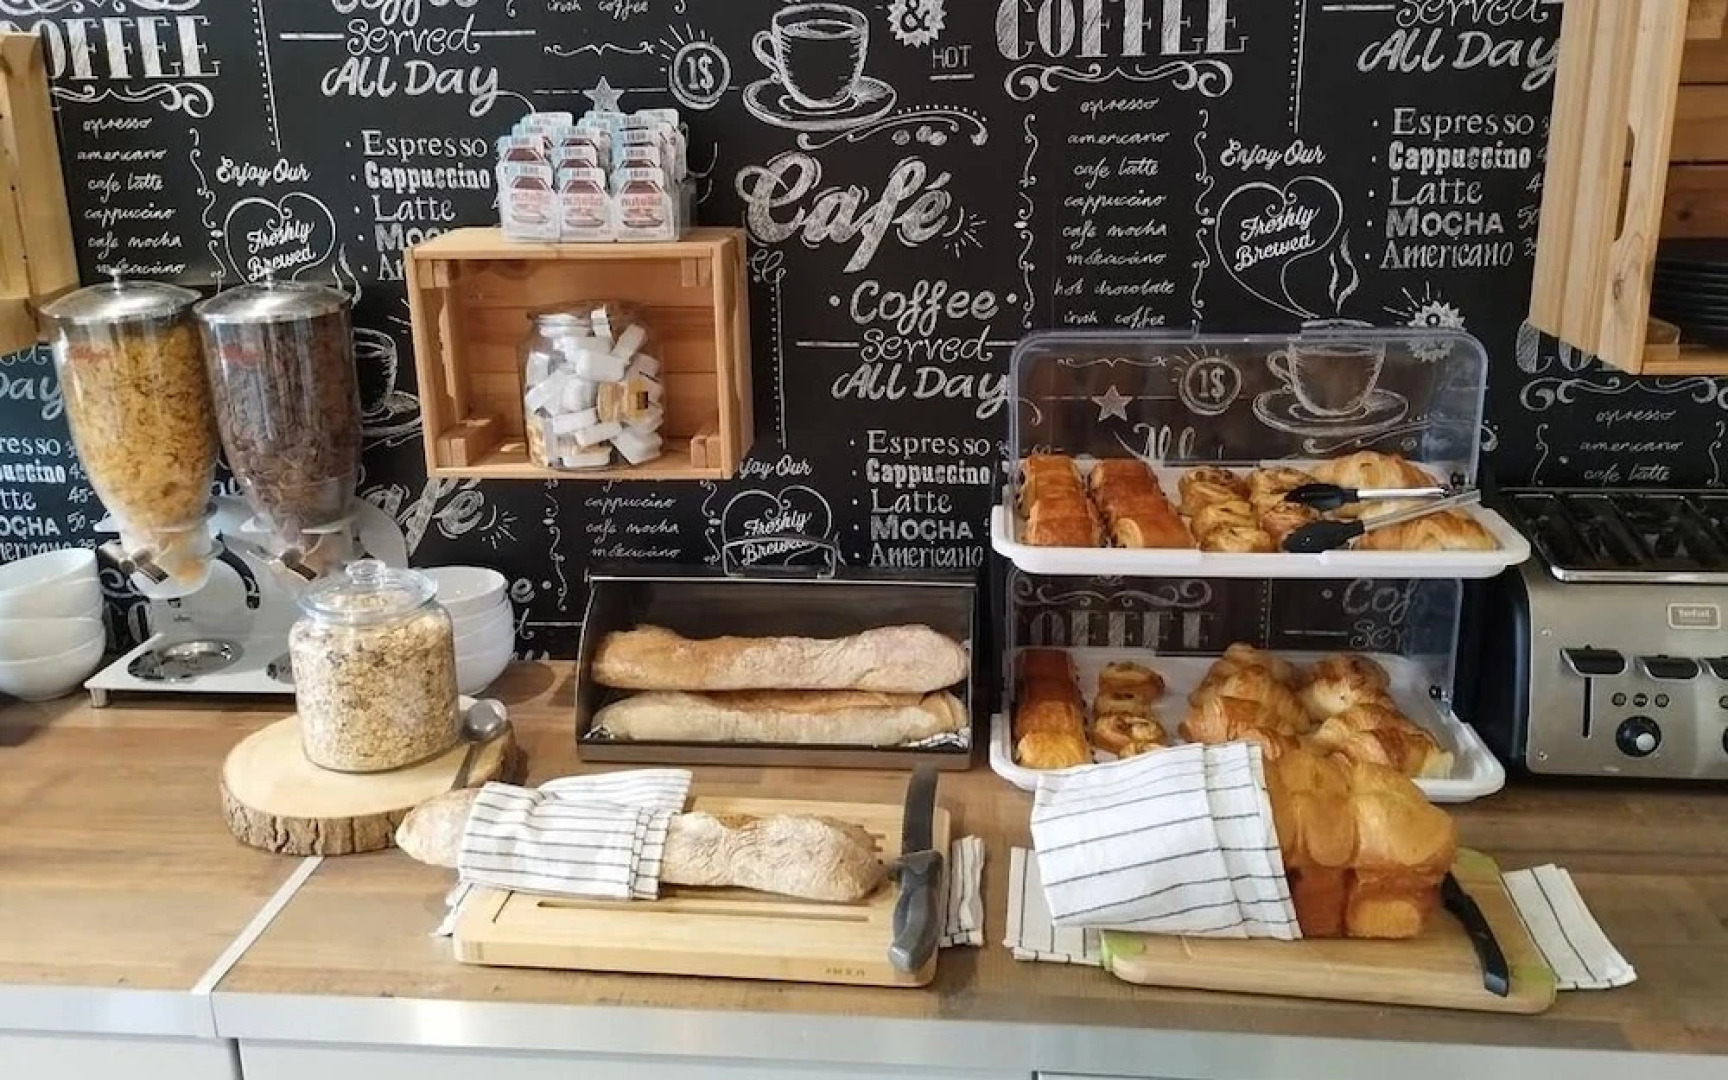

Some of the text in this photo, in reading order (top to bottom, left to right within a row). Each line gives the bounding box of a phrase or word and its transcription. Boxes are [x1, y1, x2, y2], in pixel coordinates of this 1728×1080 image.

[347, 13, 481, 56] Served
[996, 0, 1248, 60] COFFEE
[0, 16, 221, 80] OFFEE
[932, 45, 972, 69] HOT
[1357, 28, 1559, 92] All Day
[321, 57, 499, 117] All Day
[1392, 107, 1535, 140] Espresso
[361, 129, 488, 157] Espresso
[1220, 138, 1327, 171] Enjoy Our
[1389, 139, 1532, 175] Cappuccino
[216, 156, 311, 187] Enjoy Our
[365, 160, 489, 194] Cappuccino
[1074, 156, 1159, 190] cafe latte
[88, 172, 163, 203] cafe latte
[1064, 189, 1167, 216] cappuccino
[1390, 176, 1484, 206] Latte
[85, 202, 176, 228] cappuccino
[373, 195, 456, 221] Latte
[736, 152, 952, 274] Café
[1240, 205, 1320, 242] Freshly
[127, 230, 182, 248] mocha
[246, 220, 316, 254] Freshly
[1106, 219, 1167, 237] mocha
[1386, 210, 1504, 240] MOCHA
[247, 242, 317, 281] Brewed
[1233, 229, 1317, 272] Brewed
[1380, 240, 1514, 270] Americano
[851, 279, 999, 336] Coffee
[1115, 305, 1166, 329] coffee
[860, 325, 994, 363] Served
[0, 372, 63, 421] ay
[831, 363, 1012, 419] All Day
[866, 430, 991, 460] Espresso
[776, 454, 813, 477] Our
[866, 457, 990, 488] Cappuccino
[1584, 463, 1671, 489] cafe latte
[584, 493, 677, 515] cappuccino
[870, 488, 953, 514] Latte
[625, 518, 680, 535] mocha
[743, 510, 813, 536] Freshly
[870, 514, 974, 544] MOCHA
[868, 542, 984, 568] Americano
